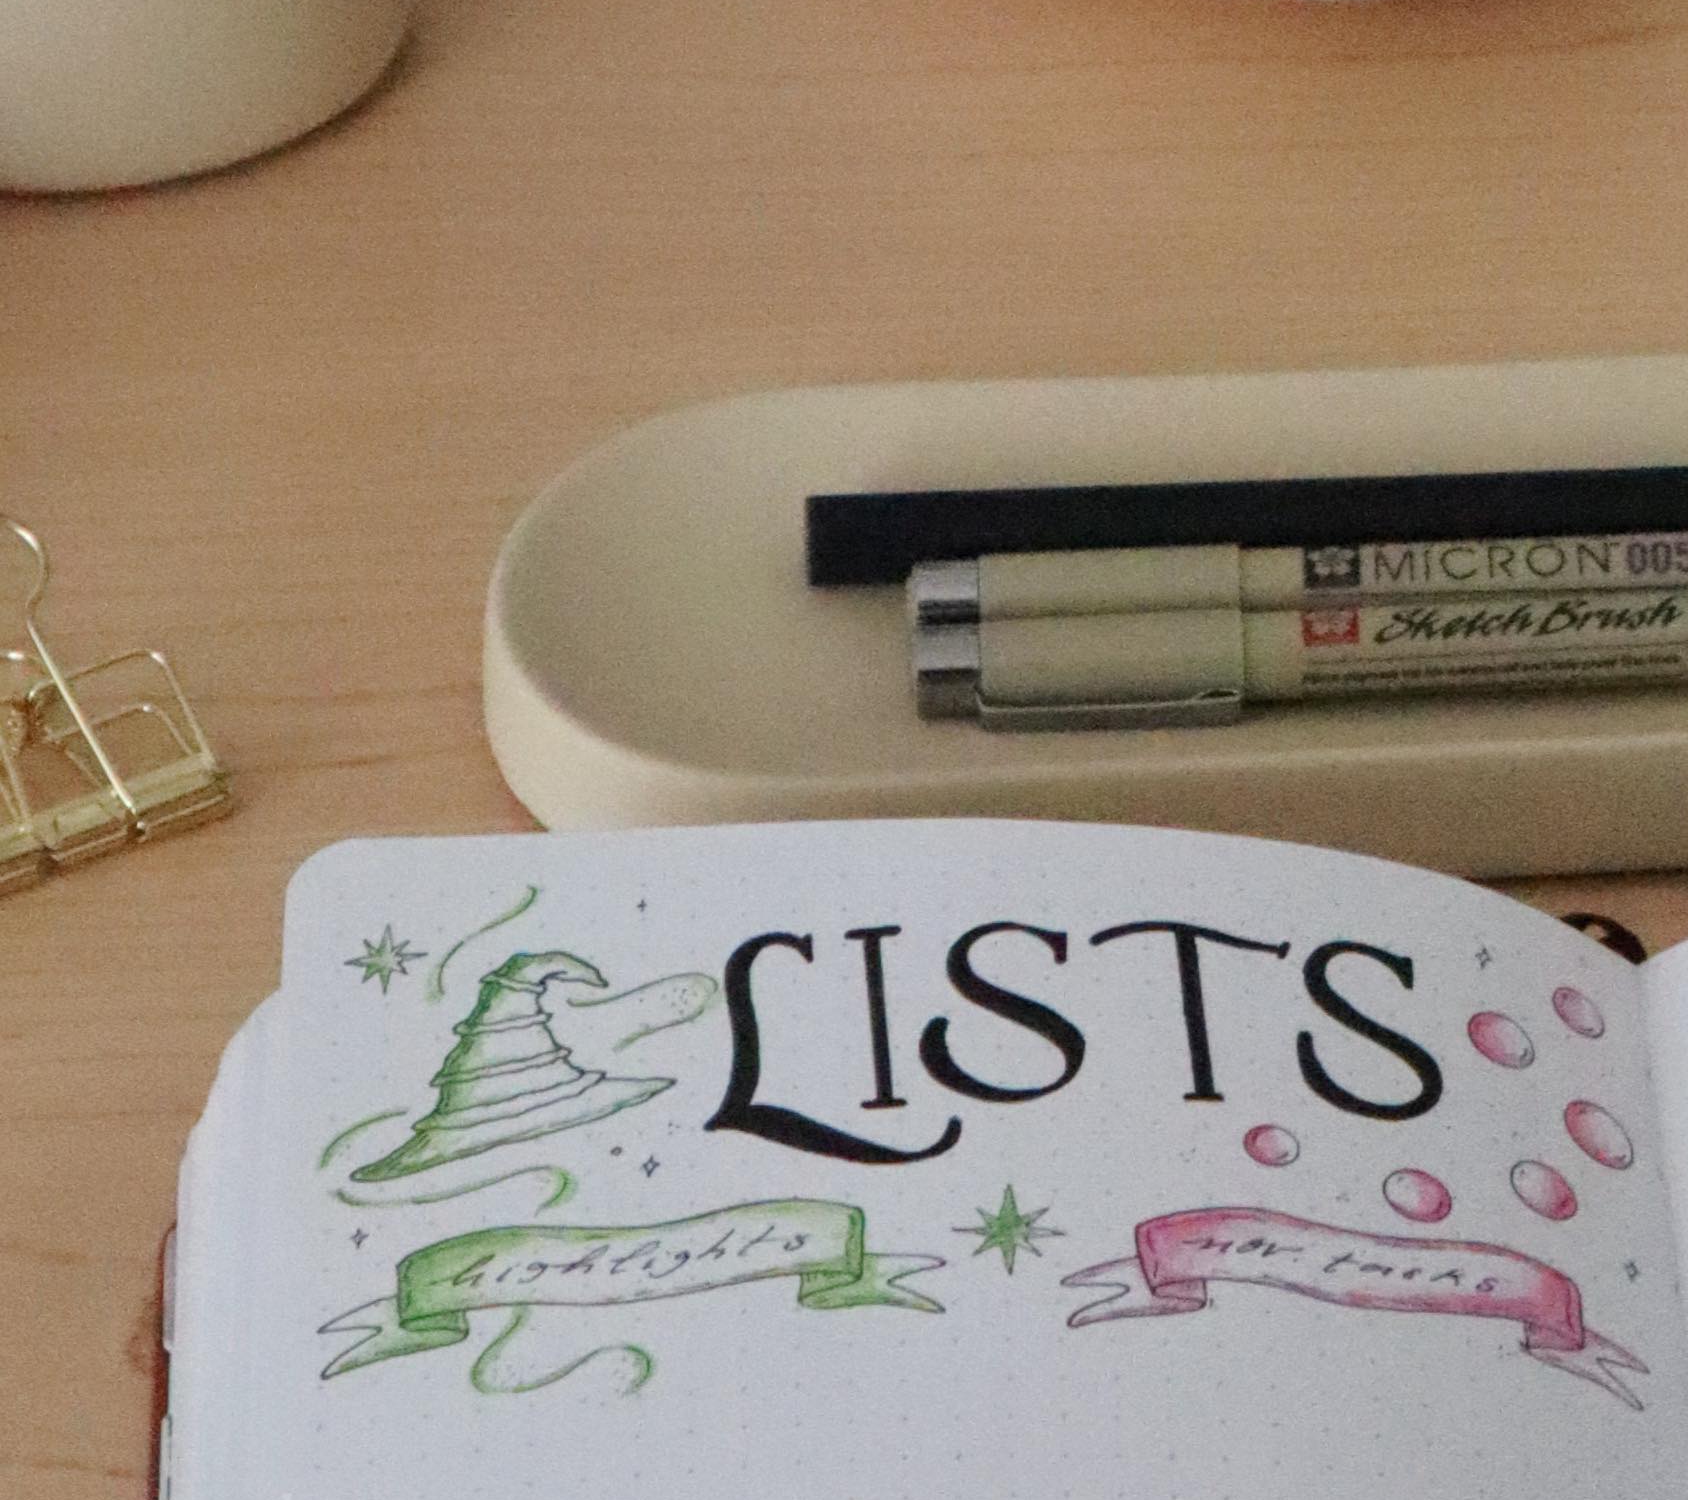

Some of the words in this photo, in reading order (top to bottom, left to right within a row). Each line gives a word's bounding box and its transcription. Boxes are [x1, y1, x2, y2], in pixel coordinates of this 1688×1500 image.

[1373, 543, 1610, 583] MICRON
[1373, 602, 1535, 645] Sketch
[1532, 596, 1684, 637] Brush
[703, 920, 1445, 1166] LISTS
[432, 1224, 811, 1287] highlights
[1322, 1251, 1499, 1295] tasks
